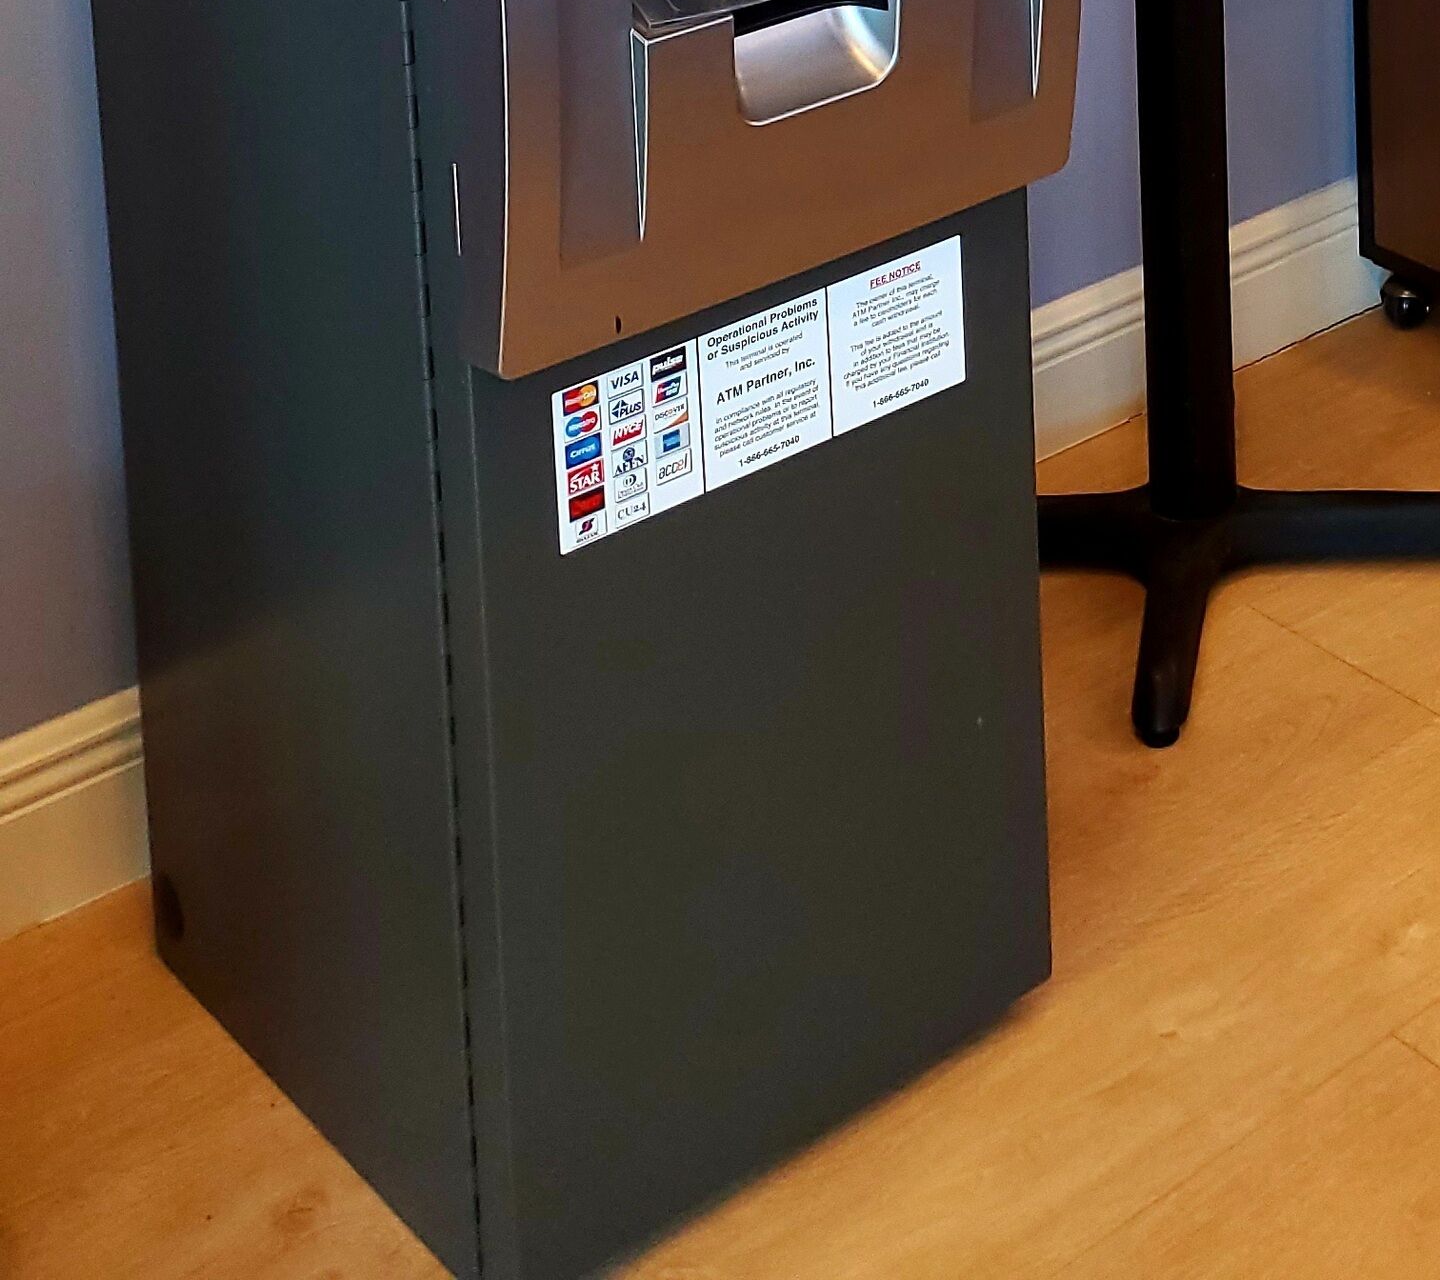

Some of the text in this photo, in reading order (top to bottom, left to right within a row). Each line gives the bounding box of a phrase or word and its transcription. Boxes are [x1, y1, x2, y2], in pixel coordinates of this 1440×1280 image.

[870, 260, 921, 289] FEE NOTICE
[707, 315, 767, 348] Operational
[769, 298, 818, 324] Problems
[707, 310, 818, 361] or Suspicious Activity
[611, 372, 639, 390] VISA
[716, 358, 816, 406] ATM Partner, Inc.
[621, 402, 641, 418] PLUS
[570, 471, 601, 493] STAR
